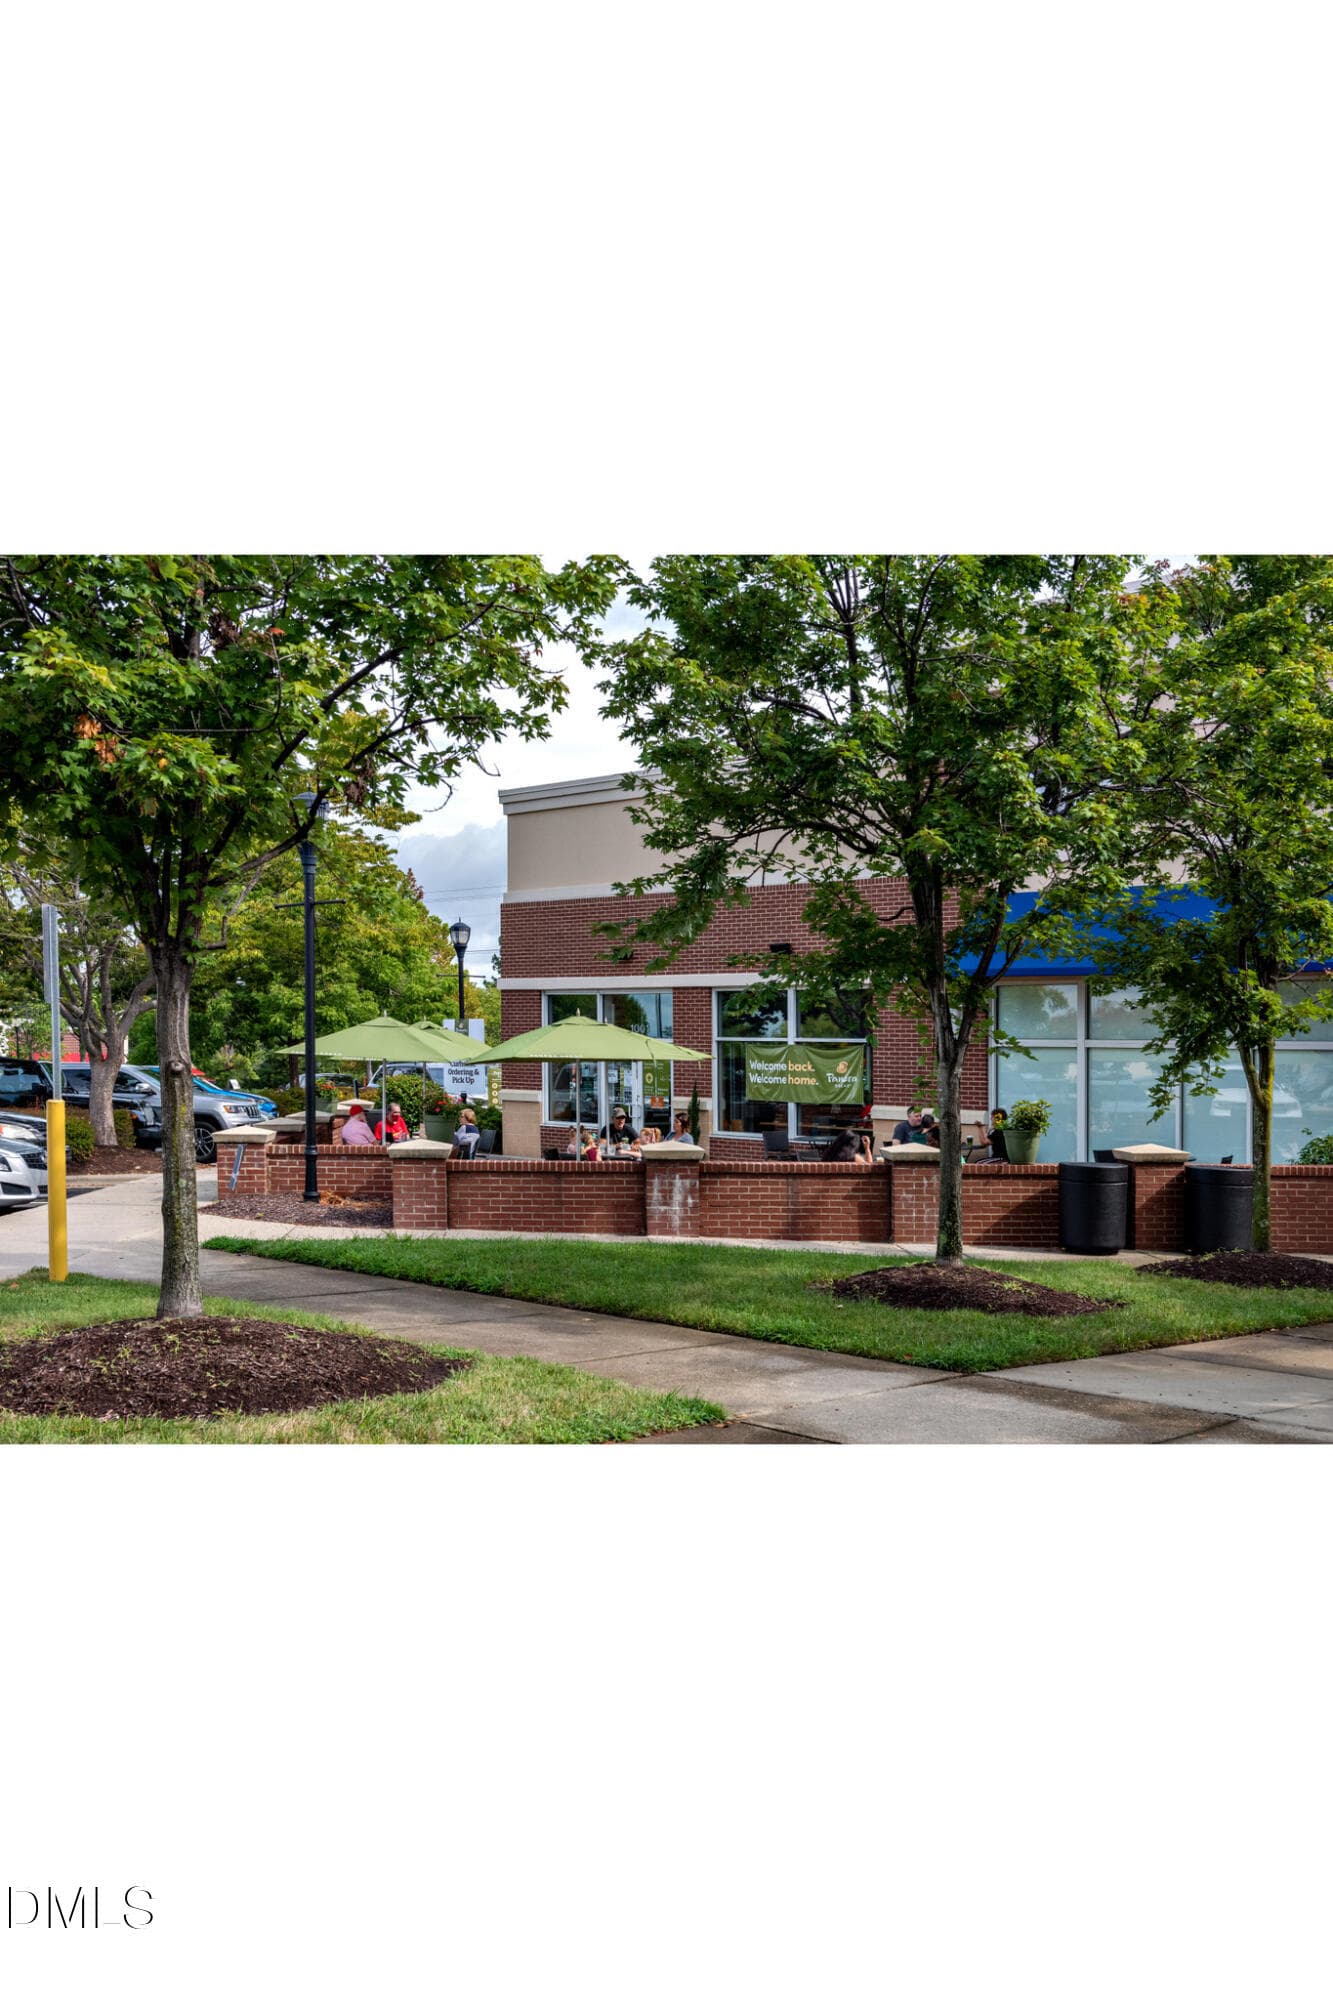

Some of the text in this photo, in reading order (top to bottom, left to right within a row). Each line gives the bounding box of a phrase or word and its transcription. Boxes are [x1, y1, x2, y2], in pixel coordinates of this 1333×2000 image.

[749, 1060, 815, 1072] Welcome back.
[466, 1077, 475, 1085] Up
[749, 1073, 819, 1086] Welcome home.
